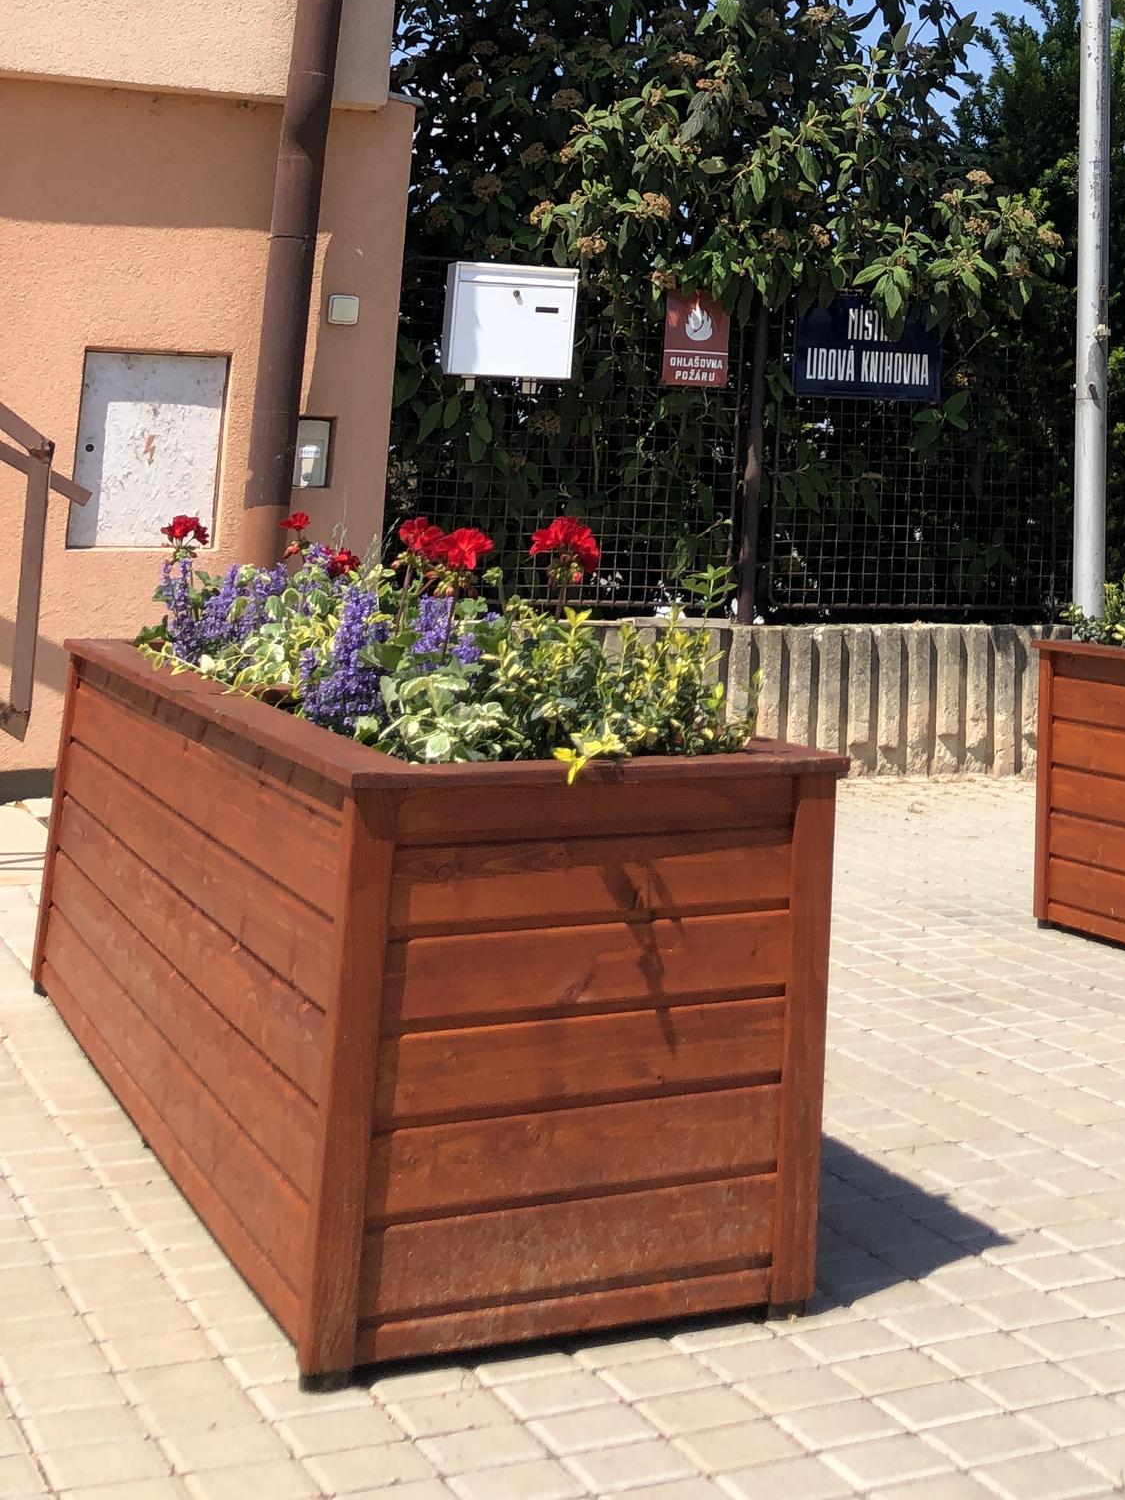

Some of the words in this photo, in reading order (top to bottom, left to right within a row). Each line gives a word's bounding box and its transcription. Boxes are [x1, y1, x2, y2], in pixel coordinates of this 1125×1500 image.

[670, 356, 723, 369] OHLAŠOVNA
[806, 345, 855, 381] LIDOVÁ
[861, 350, 929, 385] KNIHOVNA
[675, 369, 715, 381] POŽÁRU
